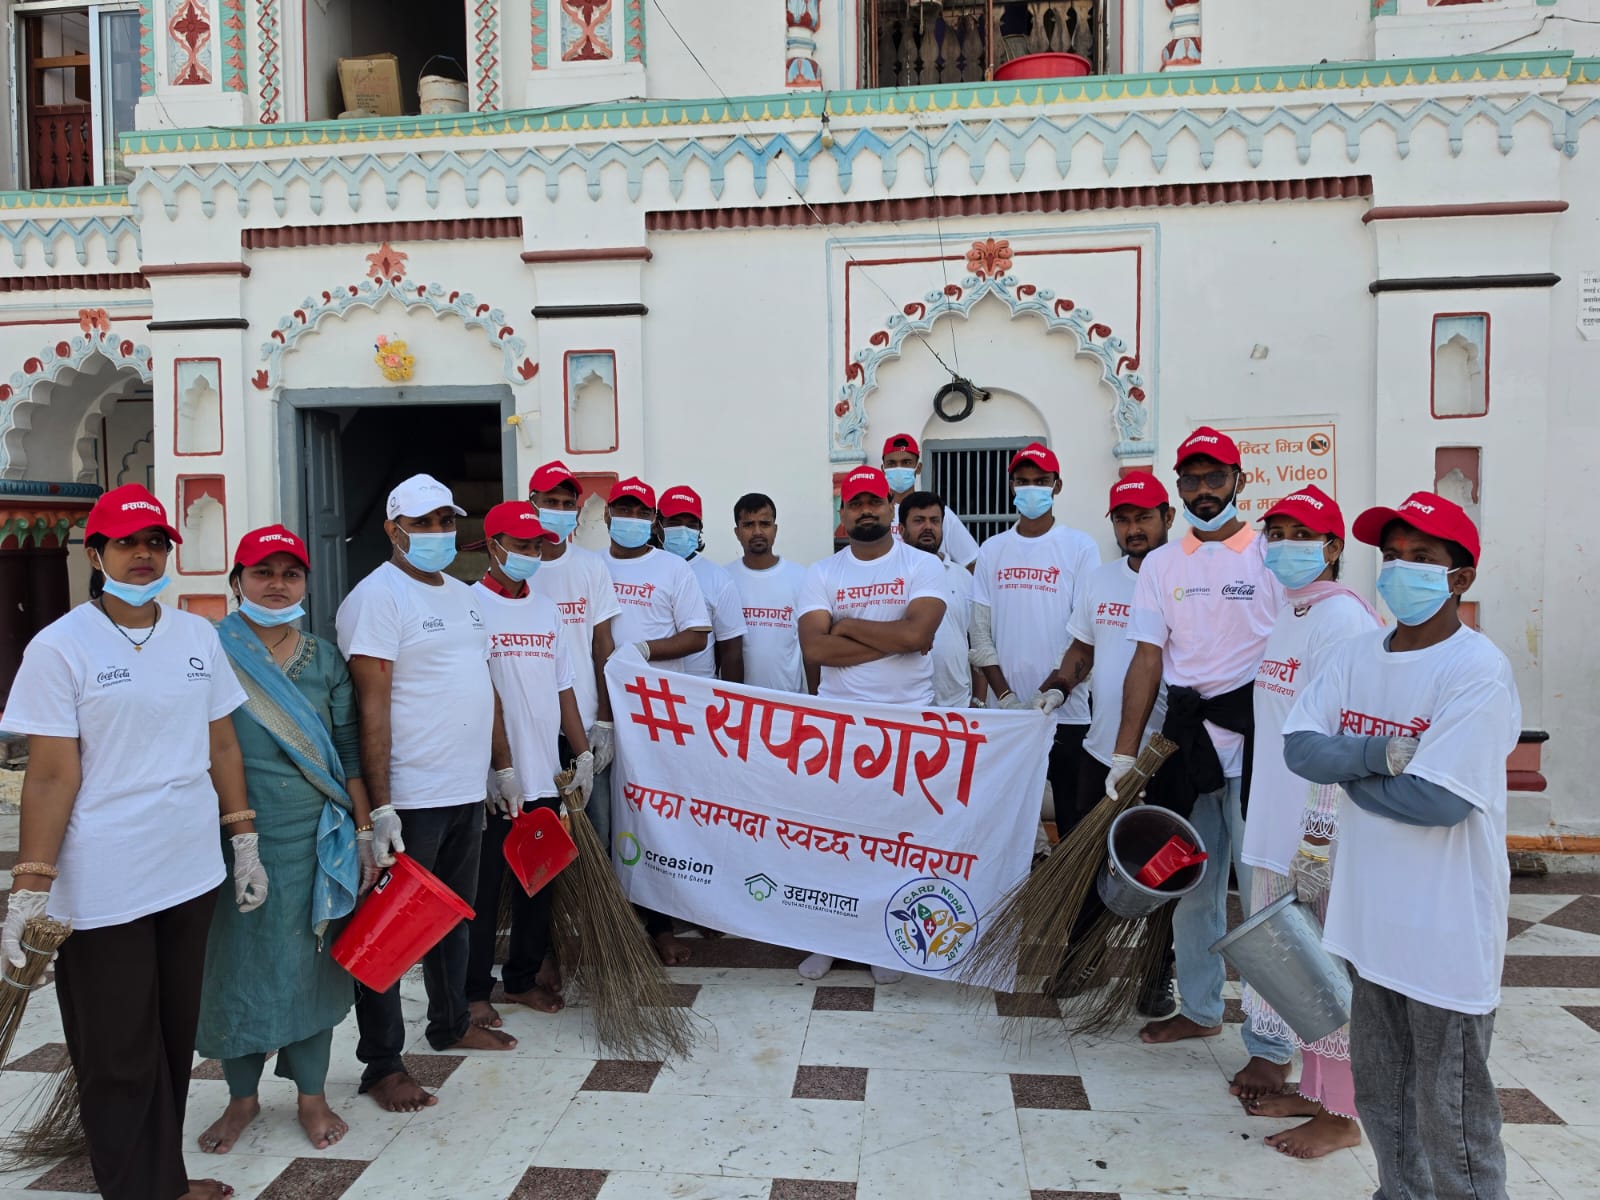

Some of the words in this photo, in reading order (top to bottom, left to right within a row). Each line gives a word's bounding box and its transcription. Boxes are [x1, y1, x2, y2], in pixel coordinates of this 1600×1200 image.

[1238, 441, 1271, 454] न्दिर
[1276, 464, 1328, 482] Video
[689, 798, 771, 842] सम्पदा
[776, 818, 854, 861] स्वच्छ
[859, 832, 979, 881] पर्यावरण
[645, 850, 714, 876] creasion
[783, 884, 860, 913] उद्यमशाला
[903, 884, 936, 905] CARD
[940, 886, 967, 915] Nepal
[944, 937, 964, 962] 2074
